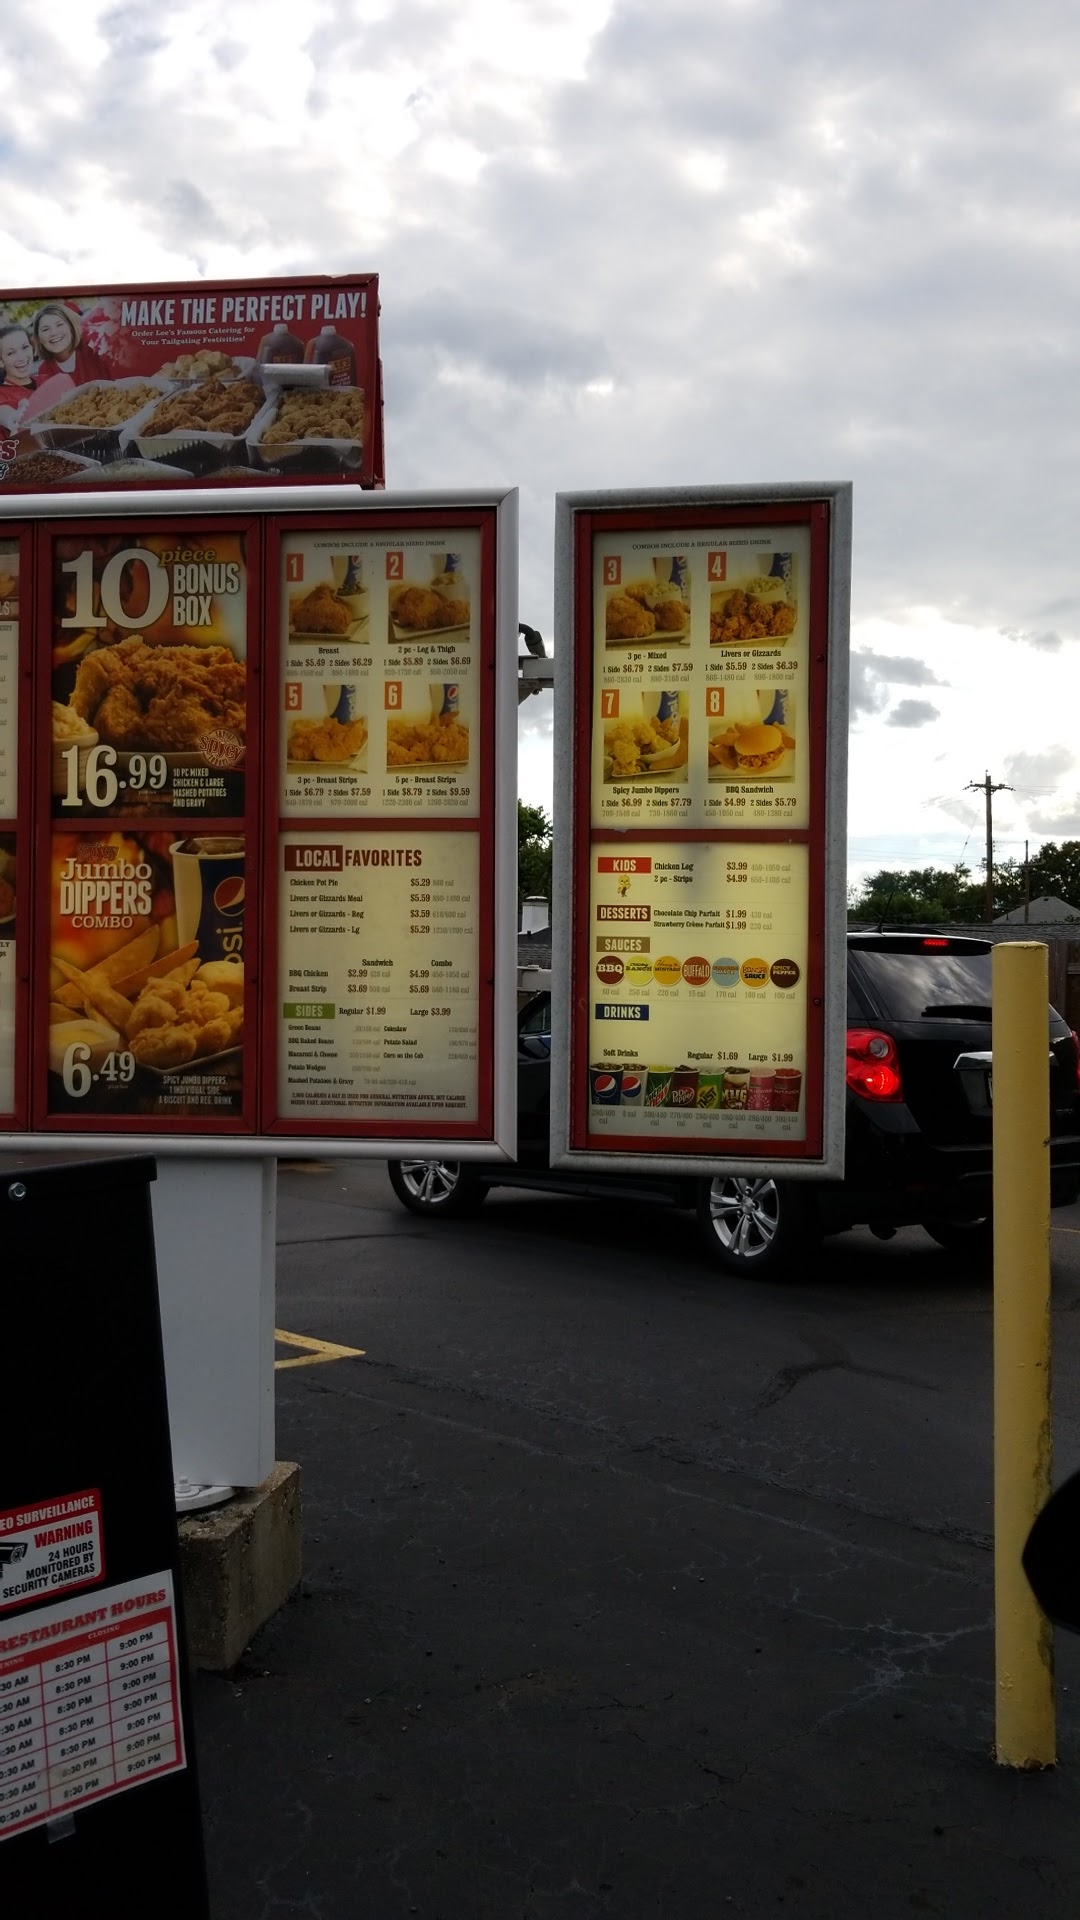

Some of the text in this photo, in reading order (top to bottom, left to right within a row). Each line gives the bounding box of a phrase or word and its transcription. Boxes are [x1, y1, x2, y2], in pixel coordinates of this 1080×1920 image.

[121, 292, 367, 326] MAKE THE PERFECT PLAY!
[208, 327, 242, 335] Catering
[161, 337, 201, 345] Tailgating
[202, 336, 245, 344] Festivities!
[159, 549, 216, 566] piece
[389, 556, 399, 576] 2
[290, 557, 298, 578] 1
[608, 559, 617, 581] 3
[712, 556, 722, 577] 4
[173, 563, 240, 594] BONUS
[61, 548, 170, 629] 10
[173, 596, 212, 627] BOX
[721, 650, 741, 658] Livers
[752, 650, 781, 658] Gizzards
[623, 664, 644, 673] $6.79
[653, 664, 669, 672] Sides
[672, 663, 693, 672] $7.59
[710, 663, 723, 671] Side
[726, 662, 747, 671] $5.59
[758, 662, 773, 670] Sides
[776, 661, 798, 670] $6.39
[288, 686, 298, 707] 5
[388, 685, 398, 706] 6
[605, 693, 614, 714] 7
[710, 690, 720, 713] 8
[61, 744, 168, 807] 16.99
[172, 768, 209, 777] 10 PC MIXED
[172, 788, 227, 797] MASHED POTATOES
[613, 786, 679, 795] Spicy Jumbo Dippers
[726, 786, 740, 794] BBQ
[172, 799, 206, 808] AND GRAVY
[621, 798, 643, 807] $6.99
[652, 799, 668, 807] Sides
[671, 798, 692, 807] $7.79
[709, 799, 722, 807] Side
[724, 798, 746, 806] $4.99
[756, 799, 772, 807] Sides
[775, 798, 796, 807] $5.79
[296, 849, 422, 867] LOCAL FAVORITES
[613, 859, 636, 871] KIDS
[681, 863, 694, 871] Leg
[727, 862, 747, 871] $3.99
[60, 857, 153, 881] Jumbo
[410, 879, 431, 887] $5.29
[60, 880, 152, 916] DIPPERS
[410, 894, 430, 902] $5.59
[600, 907, 648, 920] DESSERTS
[684, 910, 697, 918] Chip
[726, 909, 747, 918] $1.99
[72, 916, 133, 929] COMBO
[726, 921, 747, 930] $1.99
[605, 939, 642, 951] SAUCES
[362, 959, 393, 967] Sandwich
[597, 964, 623, 974] BBQ
[684, 964, 710, 977] BUFFALO
[348, 969, 367, 977] $2.99
[410, 970, 429, 978] $4.99
[348, 985, 367, 993] $3.69
[410, 985, 429, 993] $5.69
[295, 1005, 451, 1017] SIDES Regular $1.99 Large $3.99
[604, 1006, 641, 1019] DRINKS
[687, 1051, 713, 1060] Regular
[717, 1052, 738, 1060] $1.69
[749, 1053, 768, 1061] Large
[772, 1054, 793, 1062] $1.99
[62, 1042, 137, 1098] 6.49
[16, 1496, 95, 1527] SURVEILLANCE
[34, 1520, 93, 1548] WARNING
[48, 1541, 93, 1562] 24 HOURS
[26, 1552, 94, 1580] MONITORED BY
[3, 1563, 95, 1598] SECURITY CAMERAS
[0, 1589, 167, 1651] RESTAURANT HOURS
[88, 1624, 121, 1640] CLOSING
[55, 1632, 154, 1673] 8:30 PM 9:00 PM
[56, 1653, 154, 1694] 8:30 PM 9:00 PM
[57, 1672, 157, 1714] 8:30 PM 9:00 PM
[59, 1693, 158, 1735] 8:30 PM 9:00 PM
[60, 1712, 161, 1756] 8:30 PM 9:00 PM
